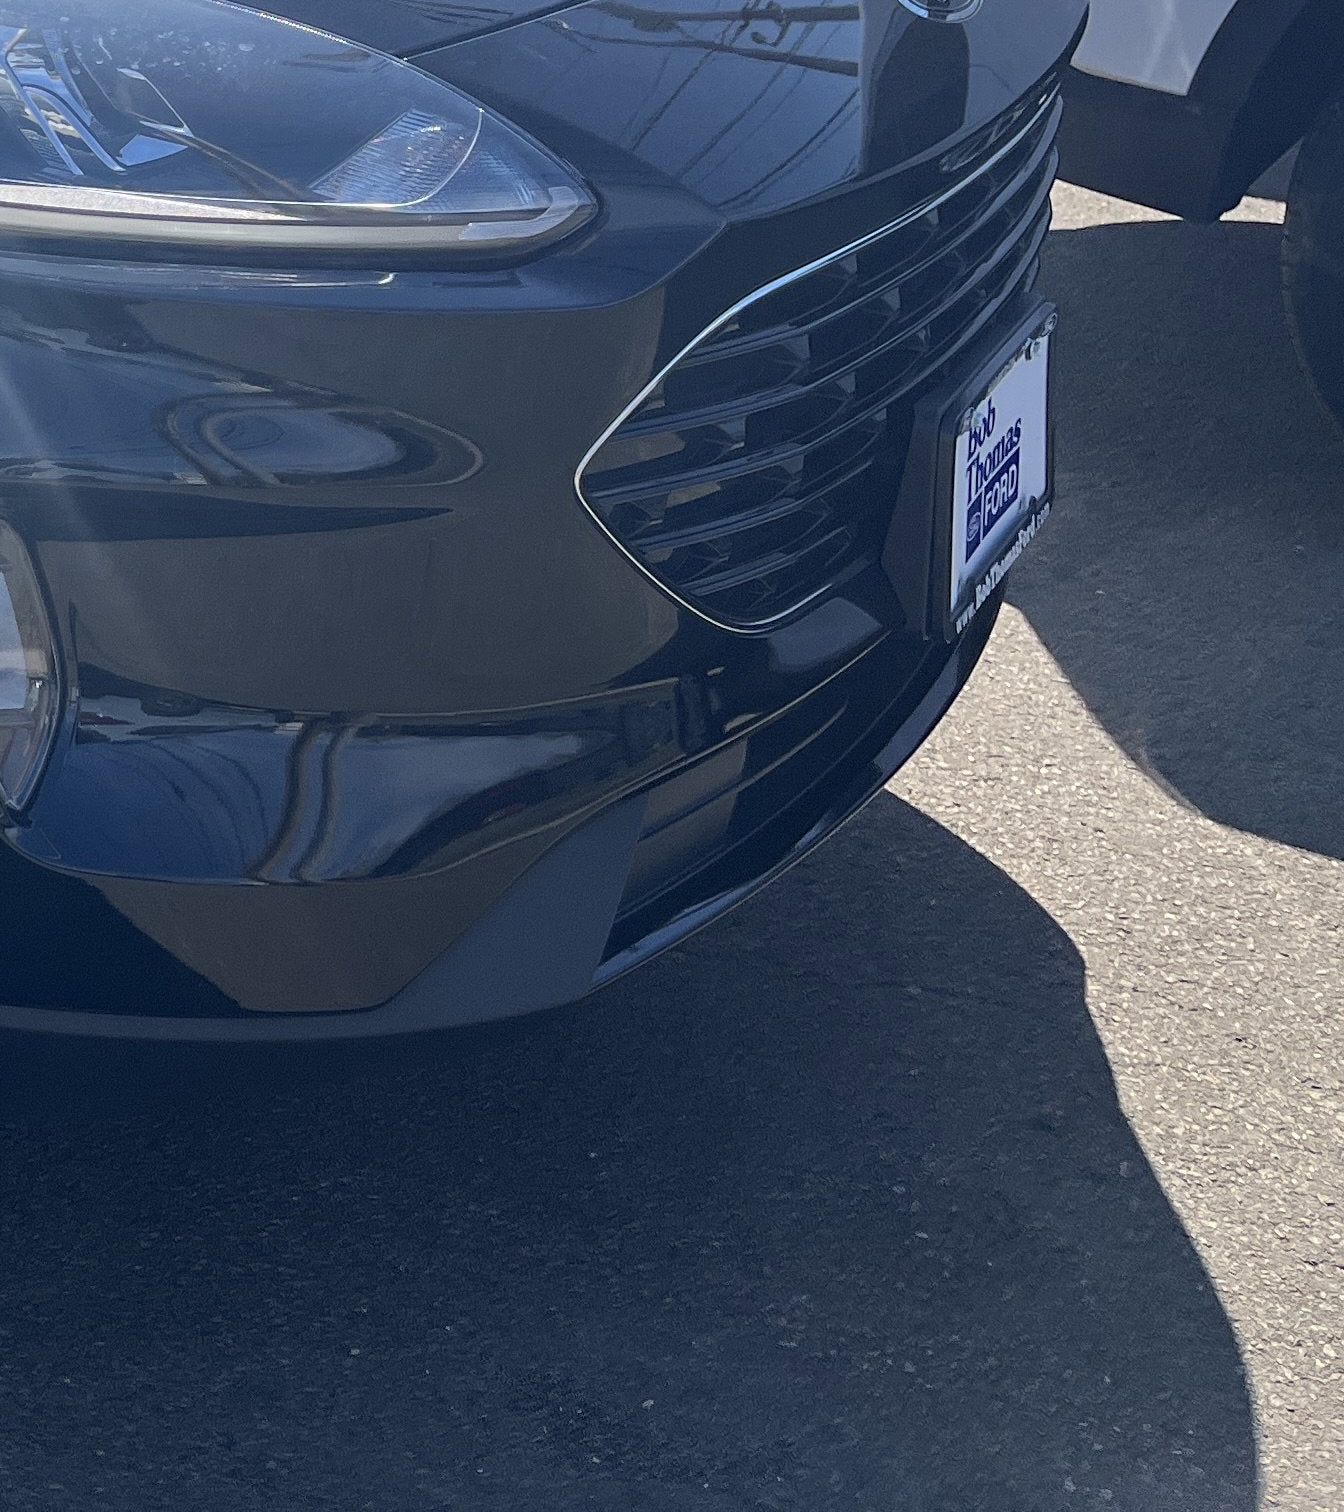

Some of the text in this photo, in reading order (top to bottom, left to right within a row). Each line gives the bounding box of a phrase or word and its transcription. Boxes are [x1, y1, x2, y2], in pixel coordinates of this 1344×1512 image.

[967, 396, 996, 462] Bob
[967, 417, 1022, 504] Thomas
[983, 463, 1018, 526] FORD
